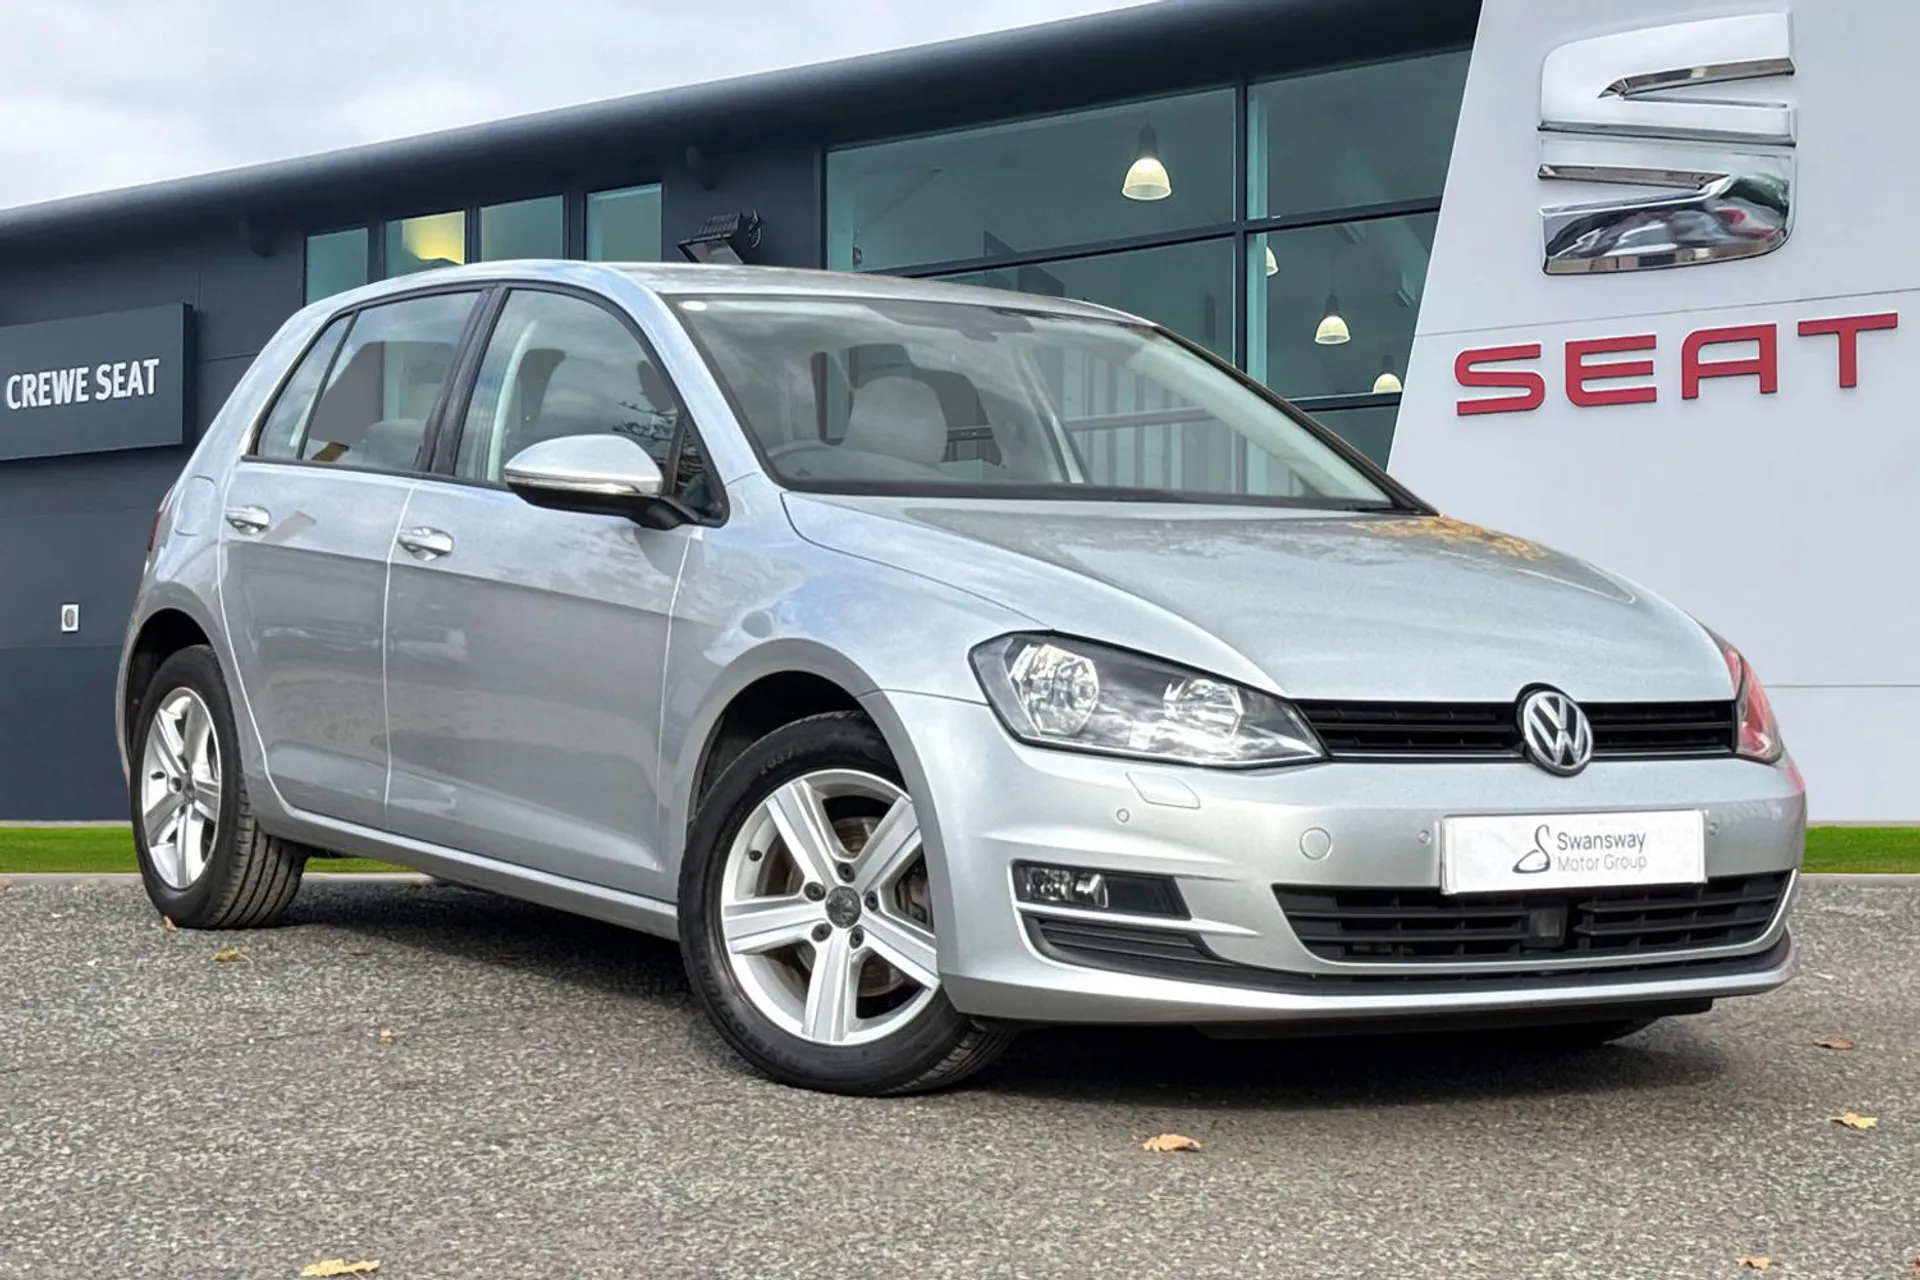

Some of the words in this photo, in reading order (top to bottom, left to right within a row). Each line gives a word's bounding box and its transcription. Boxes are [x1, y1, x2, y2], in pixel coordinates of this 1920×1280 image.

[1454, 312, 1898, 416] SEAT
[6, 366, 90, 409] CREWE
[95, 358, 160, 400] SEAT
[1556, 831, 1646, 853] Swansway
[1557, 855, 1600, 872] Motor
[1603, 853, 1647, 873] Group
